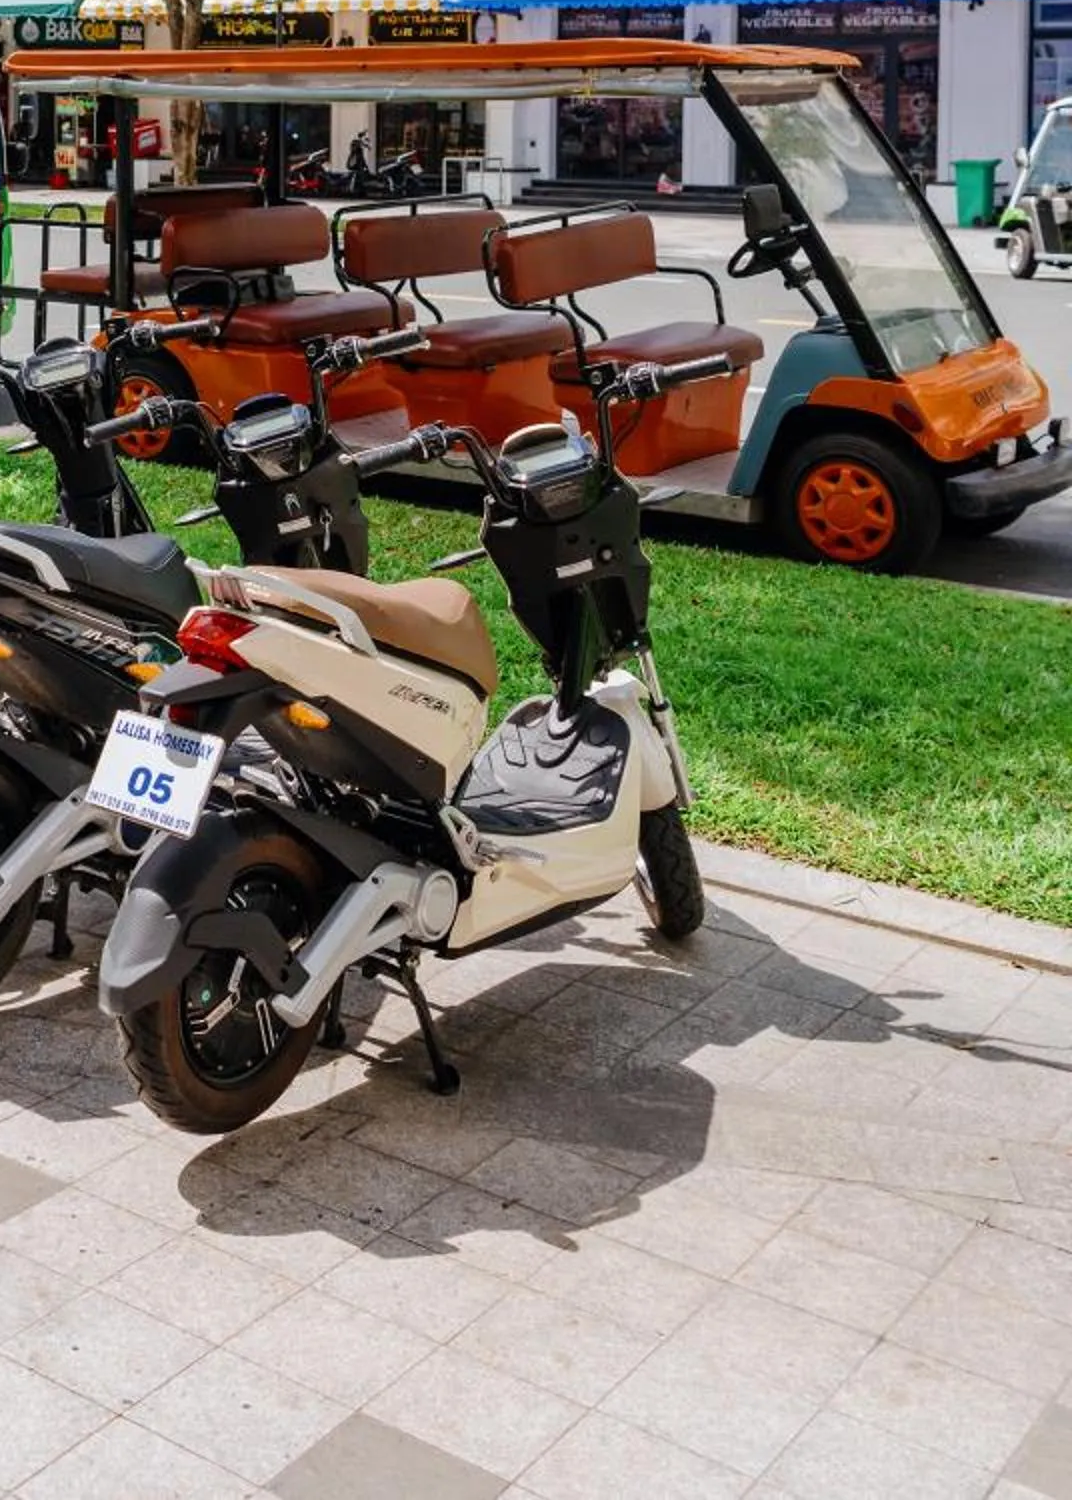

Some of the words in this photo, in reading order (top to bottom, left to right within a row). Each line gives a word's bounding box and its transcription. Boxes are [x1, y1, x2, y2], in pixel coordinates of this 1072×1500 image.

[115, 719, 151, 742] LALISA
[154, 729, 215, 761] HOMESTAY
[128, 766, 175, 805] 05
